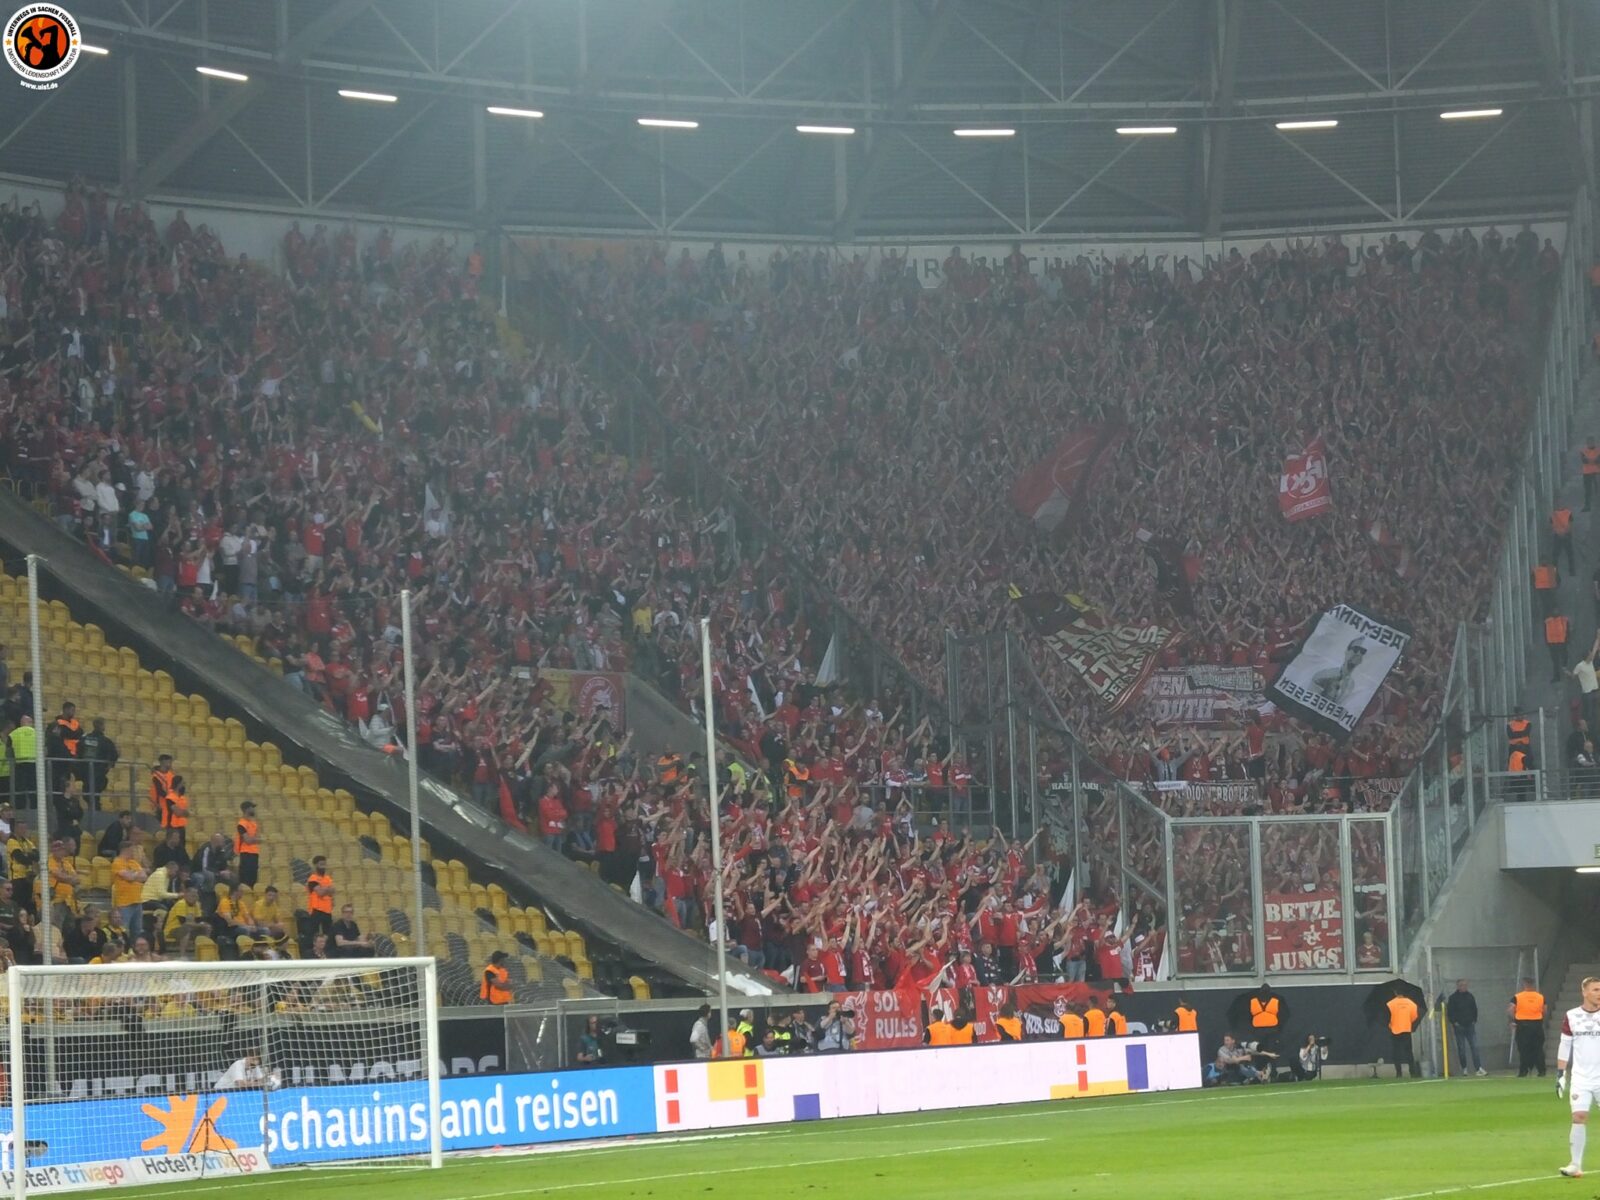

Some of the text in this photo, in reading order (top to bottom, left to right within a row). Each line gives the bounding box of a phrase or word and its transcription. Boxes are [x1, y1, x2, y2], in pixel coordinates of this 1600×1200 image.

[1264, 899, 1341, 922] BETZE
[1269, 947, 1342, 971] JUNGS
[875, 1016, 918, 1039] RULES
[259, 1078, 619, 1153] schauinsand reisen
[142, 1151, 259, 1175] Hotel? trivago
[2, 1163, 125, 1191] Htel? trivago
